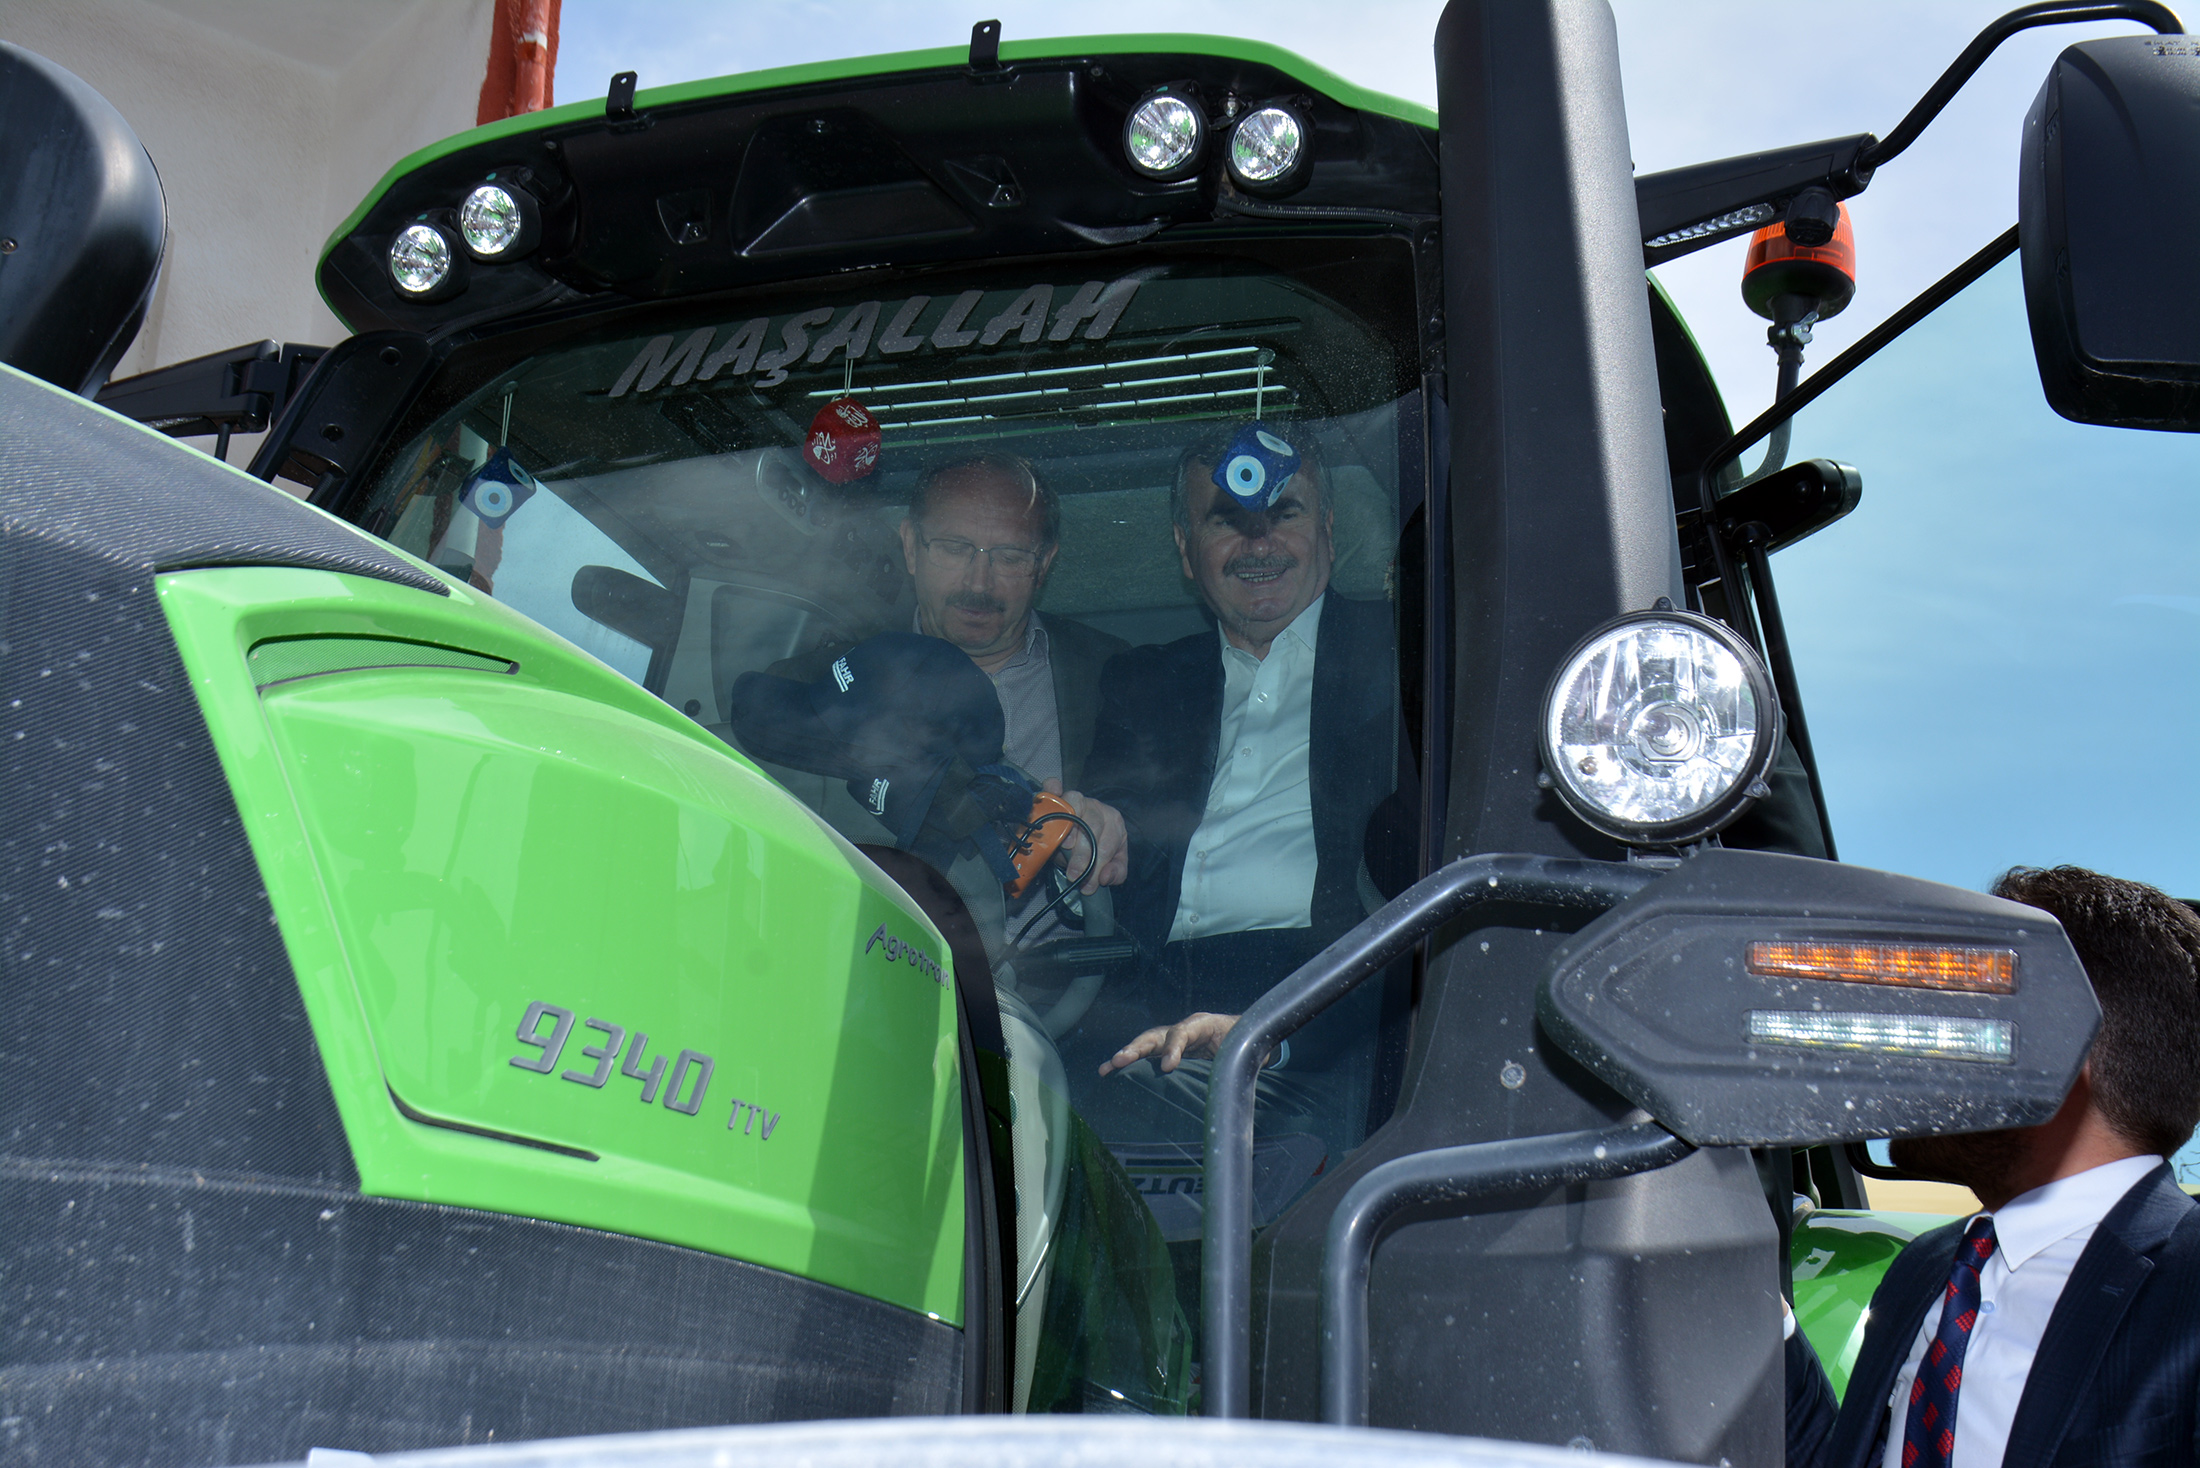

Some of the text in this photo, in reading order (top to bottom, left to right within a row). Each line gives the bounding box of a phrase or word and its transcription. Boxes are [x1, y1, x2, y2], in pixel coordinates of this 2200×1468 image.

[609, 279, 1141, 397] MAŞALLAH
[838, 656, 854, 685] FAHR
[868, 778, 882, 806] FAHR
[865, 922, 951, 990] Agrotron
[509, 1000, 781, 1141] 9340 TTV
